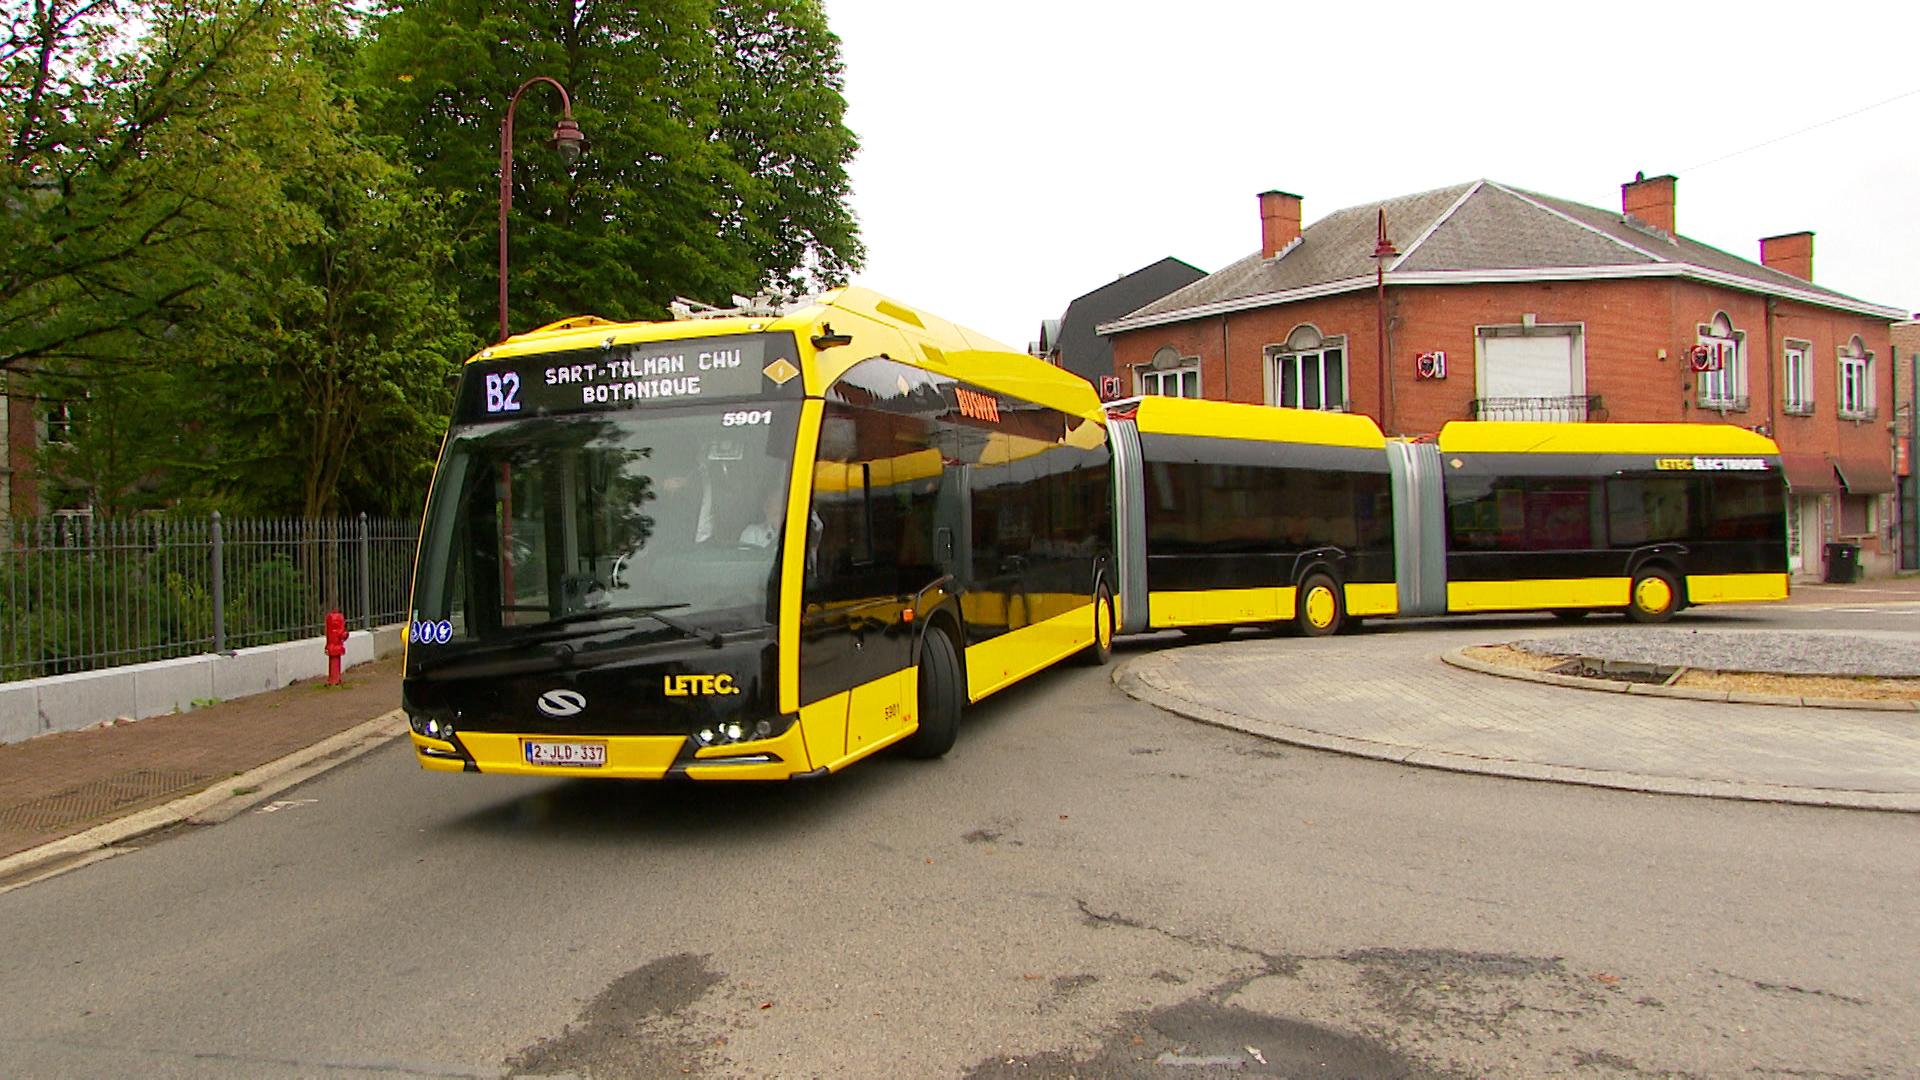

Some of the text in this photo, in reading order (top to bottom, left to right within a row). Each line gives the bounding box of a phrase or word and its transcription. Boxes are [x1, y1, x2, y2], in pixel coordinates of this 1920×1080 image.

[545, 356, 684, 384] SART-TILMAN
[486, 371, 521, 413] B2
[582, 377, 701, 404] BOTANIQUE
[722, 410, 772, 426] 5901
[955, 387, 999, 423] BUSWAY
[1656, 458, 1693, 470] LETEC
[664, 673, 740, 696] LETEC.
